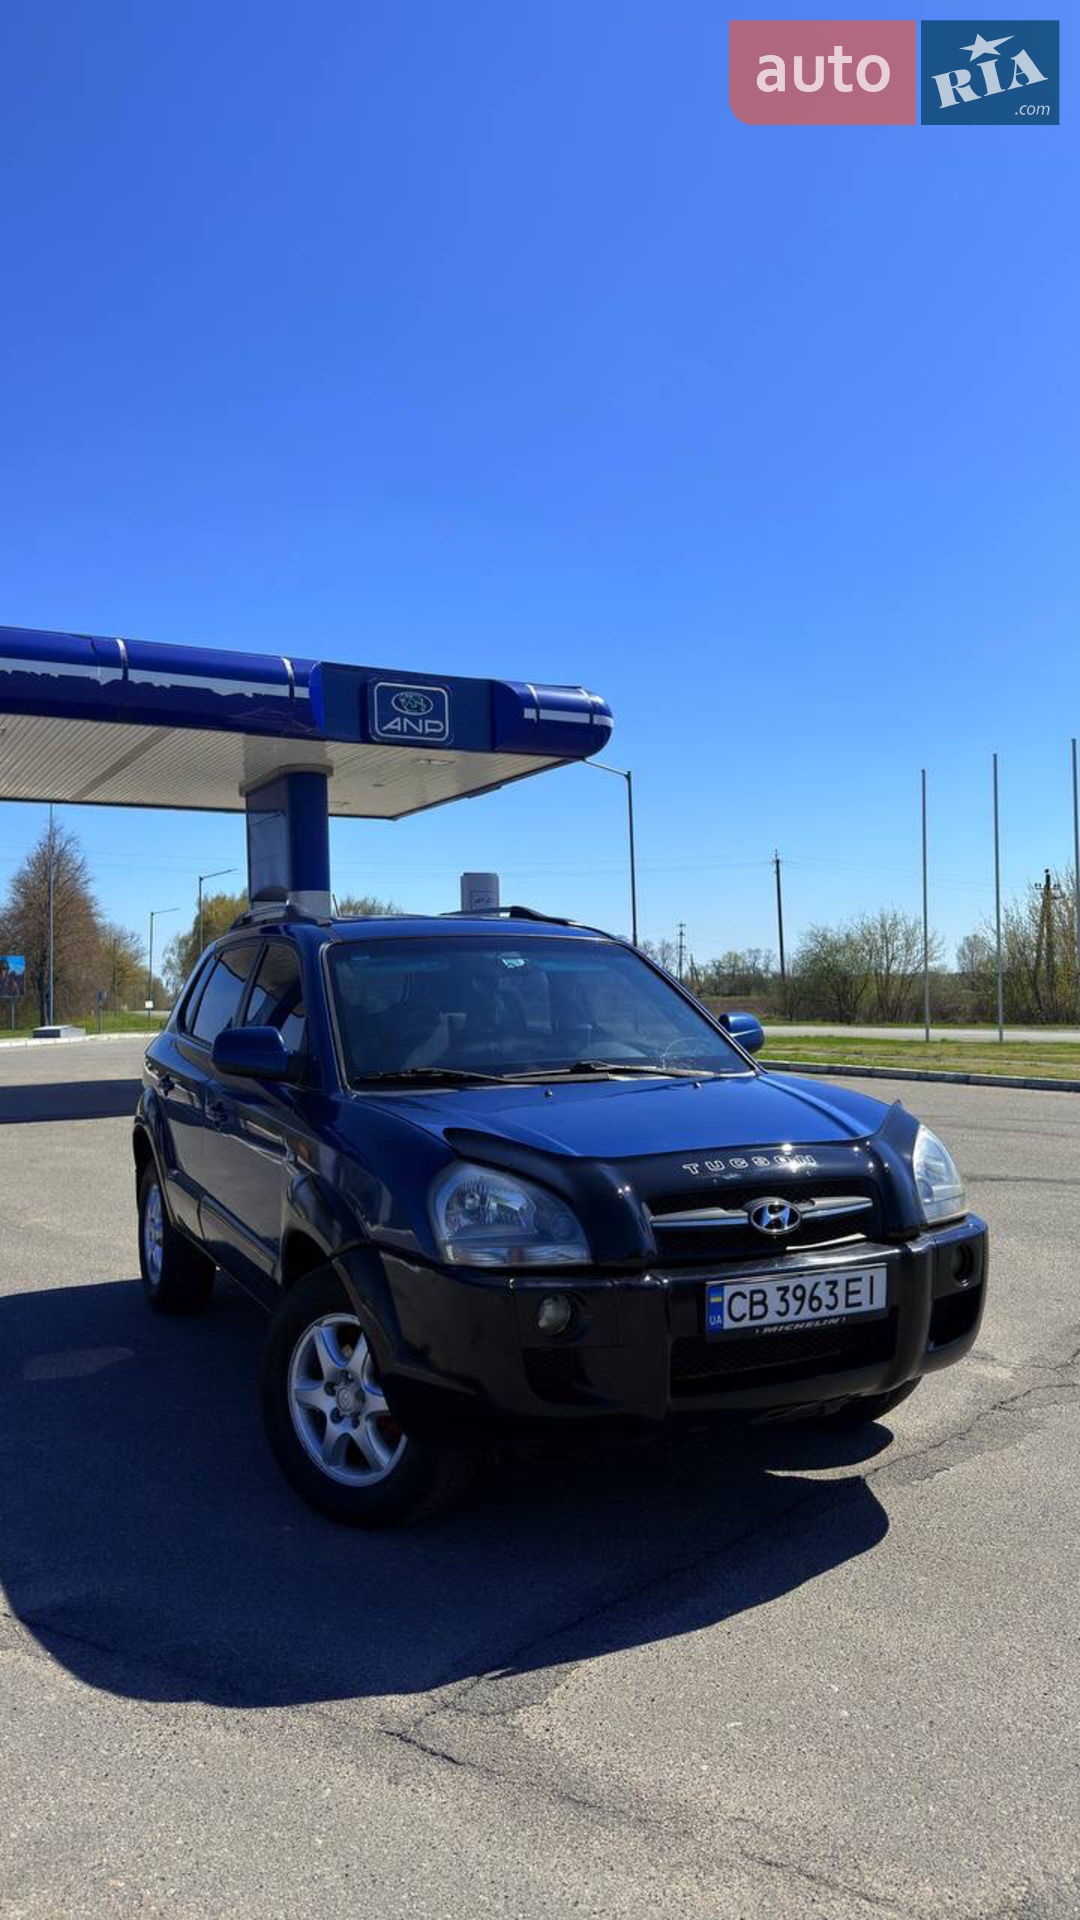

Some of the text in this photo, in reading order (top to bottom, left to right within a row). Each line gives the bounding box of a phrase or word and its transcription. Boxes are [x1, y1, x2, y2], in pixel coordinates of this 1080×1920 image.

[682, 1155, 817, 1175] TUCSON
[775, 1280, 839, 1318] 3963
[709, 1315, 722, 1326] UA
[763, 1317, 839, 1333] MICHELIN
